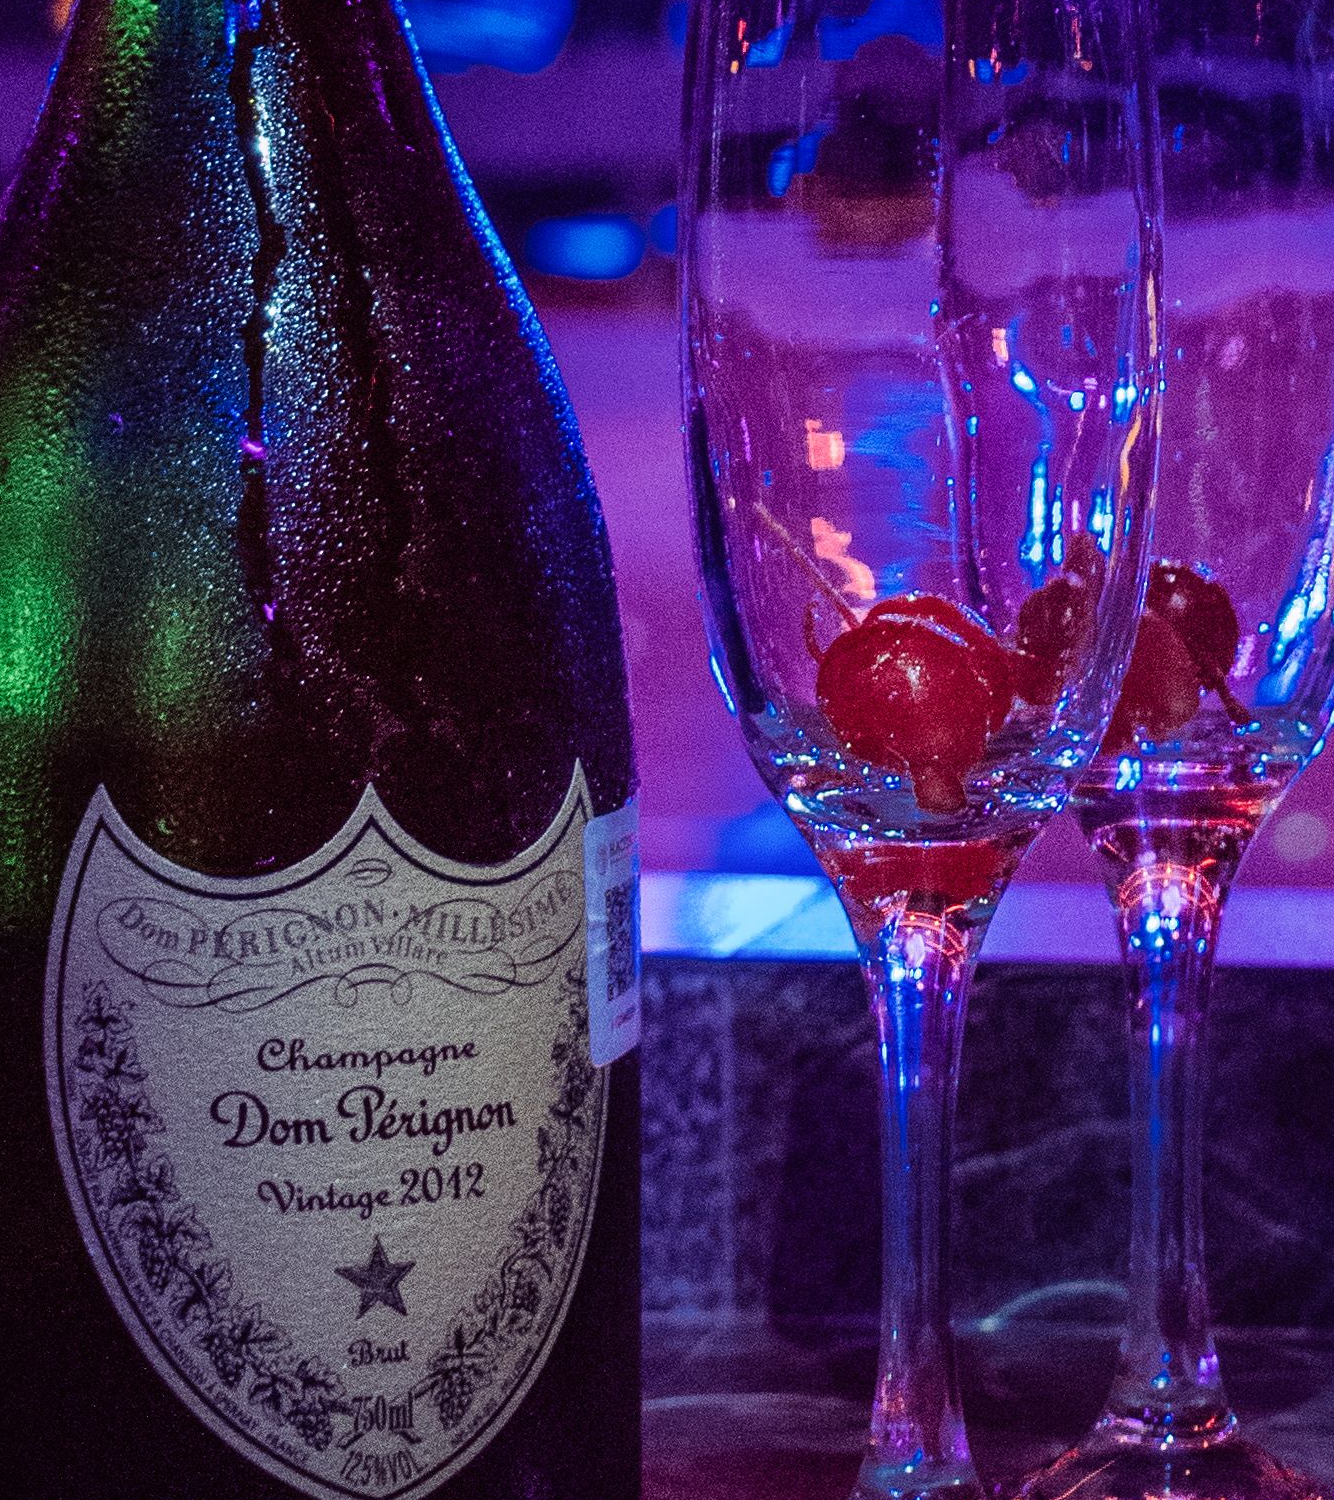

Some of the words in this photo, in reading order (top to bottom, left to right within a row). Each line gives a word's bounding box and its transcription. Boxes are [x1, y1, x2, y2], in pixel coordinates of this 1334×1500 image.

[116, 901, 179, 950] Dom
[257, 1038, 479, 1078] Champagne
[210, 1090, 333, 1148] Dom
[337, 1085, 517, 1156] Pérignon
[257, 1179, 394, 1220] Vintage
[400, 1162, 485, 1206] 2012
[348, 1338, 411, 1367] Brut
[351, 1391, 415, 1432] 750ml
